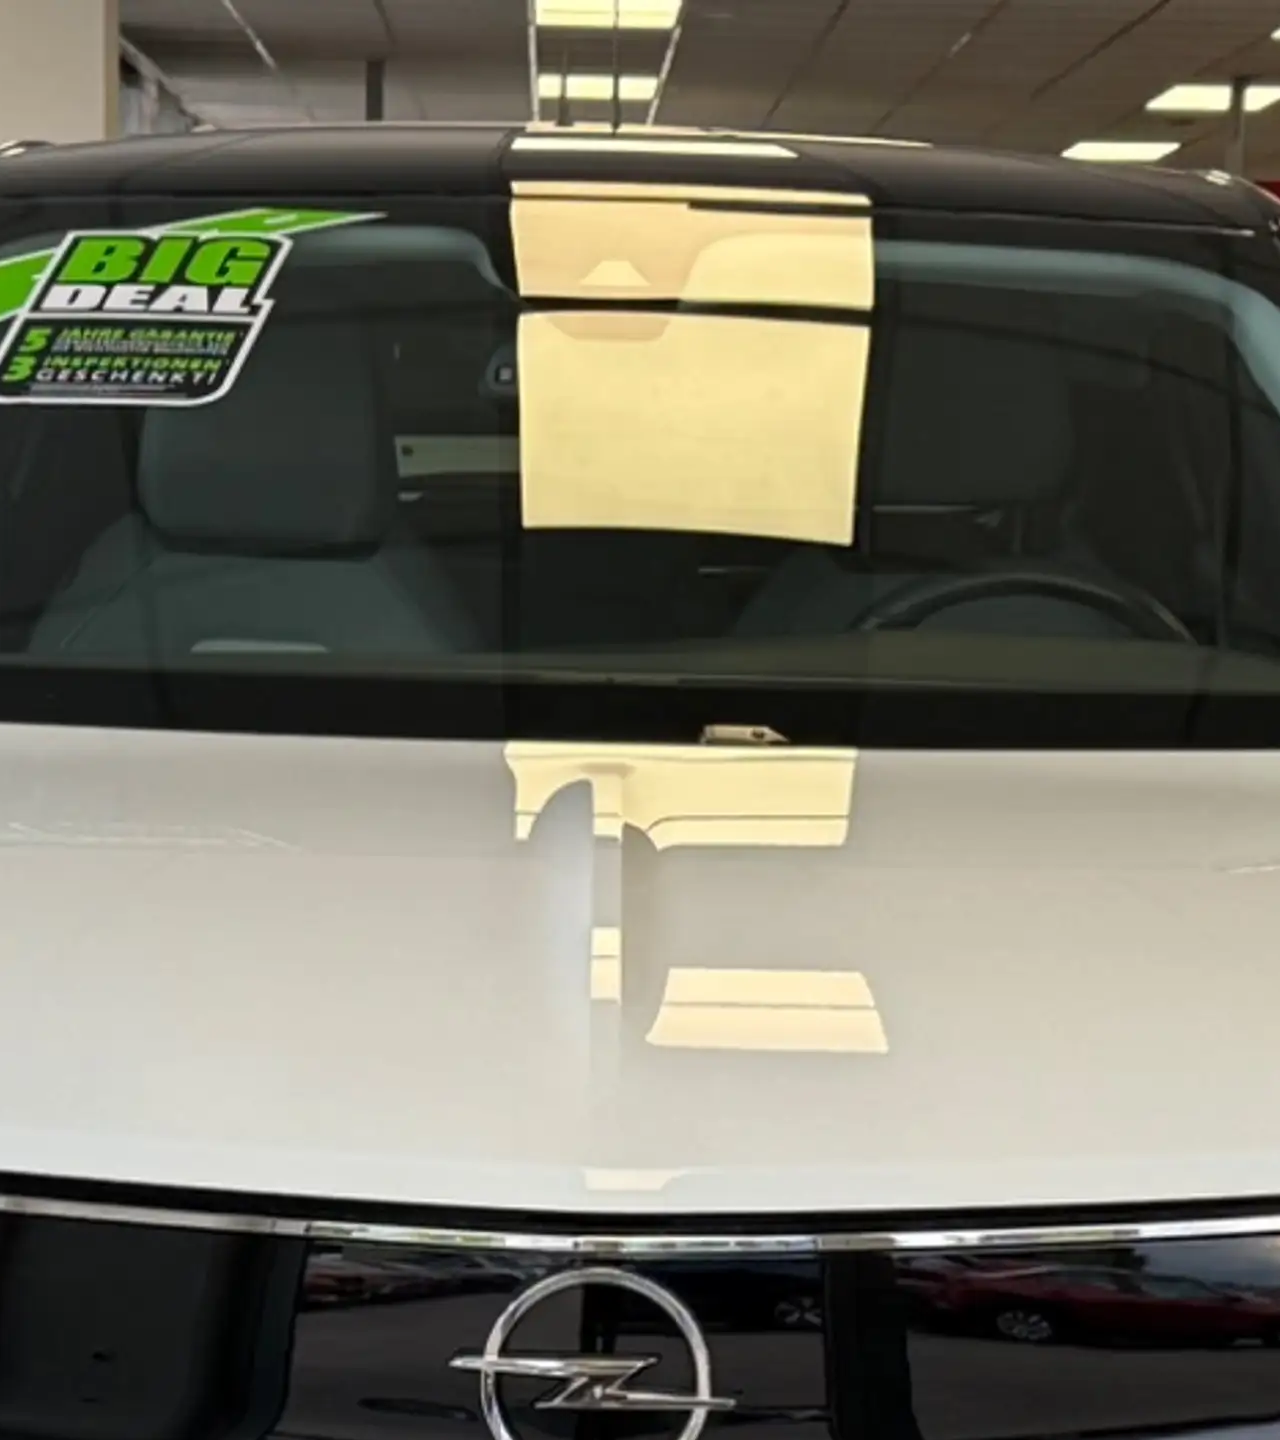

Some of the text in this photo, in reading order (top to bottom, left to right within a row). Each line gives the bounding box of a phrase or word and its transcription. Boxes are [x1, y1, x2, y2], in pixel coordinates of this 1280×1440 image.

[56, 235, 272, 286] BIG
[39, 283, 252, 314] DEAL
[18, 326, 53, 353] 5
[2, 355, 38, 382] 3
